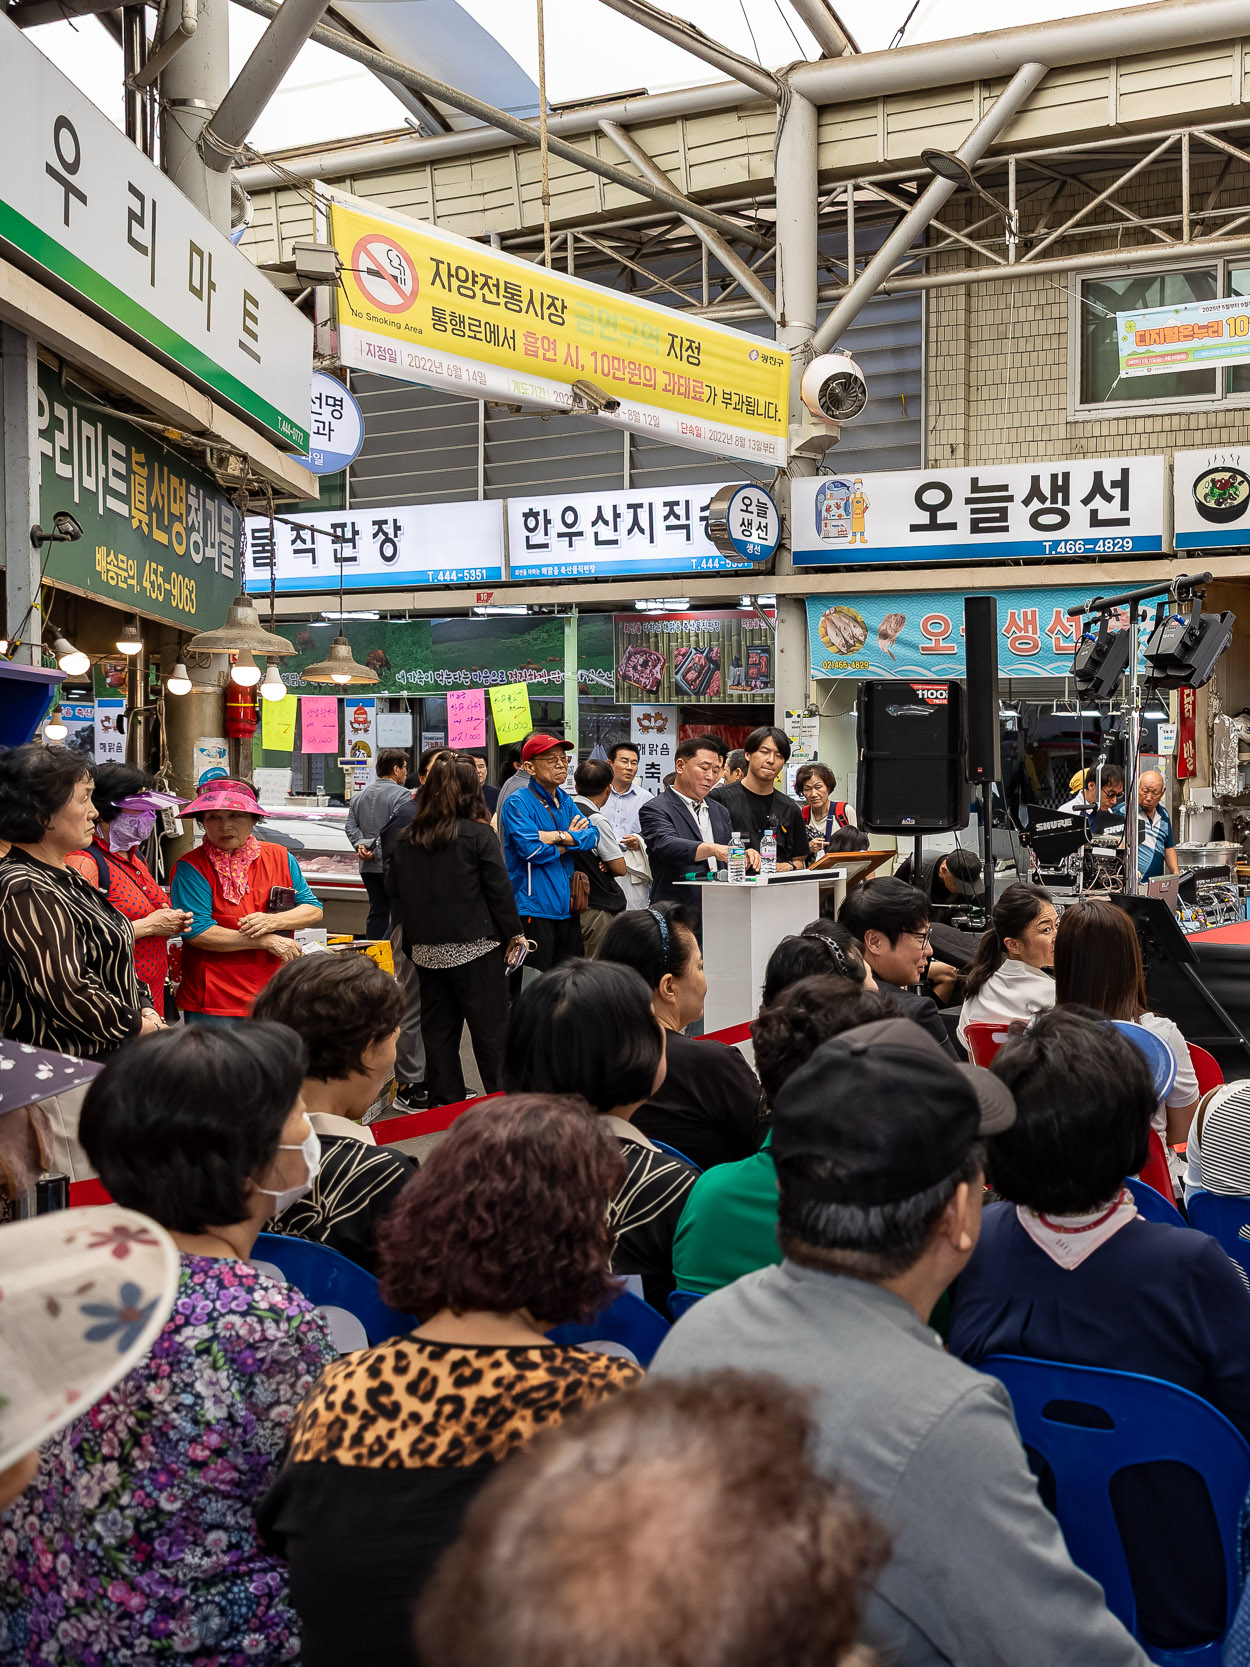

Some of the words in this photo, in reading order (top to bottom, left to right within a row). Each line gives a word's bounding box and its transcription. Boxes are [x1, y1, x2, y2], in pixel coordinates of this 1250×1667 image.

[46, 115, 261, 364] 우리마트
[430, 256, 567, 327] 자양전통시장
[667, 332, 702, 367] 지정
[366, 312, 402, 330] Smoking
[404, 322, 423, 335] Area
[1134, 320, 1223, 348] 디지털온누리
[431, 306, 517, 352] 통행로에서
[523, 331, 558, 364] 흡연
[563, 343, 585, 372] 시,
[590, 351, 657, 391] 10만원의
[662, 370, 717, 406] 과태료가
[721, 389, 782, 423] 부과됩니다.
[761, 354, 784, 367] 광진구
[366, 342, 397, 364] 지정일
[408, 353, 443, 375] 2022년
[447, 363, 462, 379] 6월
[465, 368, 487, 386] 14일
[643, 412, 660, 428] 12일
[681, 421, 702, 439] 단속일
[709, 429, 733, 445] 2022년
[735, 436, 746, 448] 8월
[748, 438, 776, 455] 13일부터
[740, 496, 768, 519] 오늘
[909, 467, 1131, 535] 오늘생선
[188, 484, 234, 579] 청과물
[740, 517, 768, 541] 생선
[746, 543, 760, 555] 생선
[1043, 538, 1133, 555] T.466-4829
[143, 560, 196, 614] 455-9063
[427, 569, 488, 583] T.444-5351
[919, 607, 1082, 655] 오생선
[407, 668, 434, 686] 가족이
[435, 669, 471, 686] 먹는다는
[472, 668, 507, 686] 마음으로
[822, 660, 870, 671] 02)466-4829
[916, 689, 946, 699] 1100
[1035, 818, 1073, 832] SHURE
[1103, 823, 1125, 835] SHU
